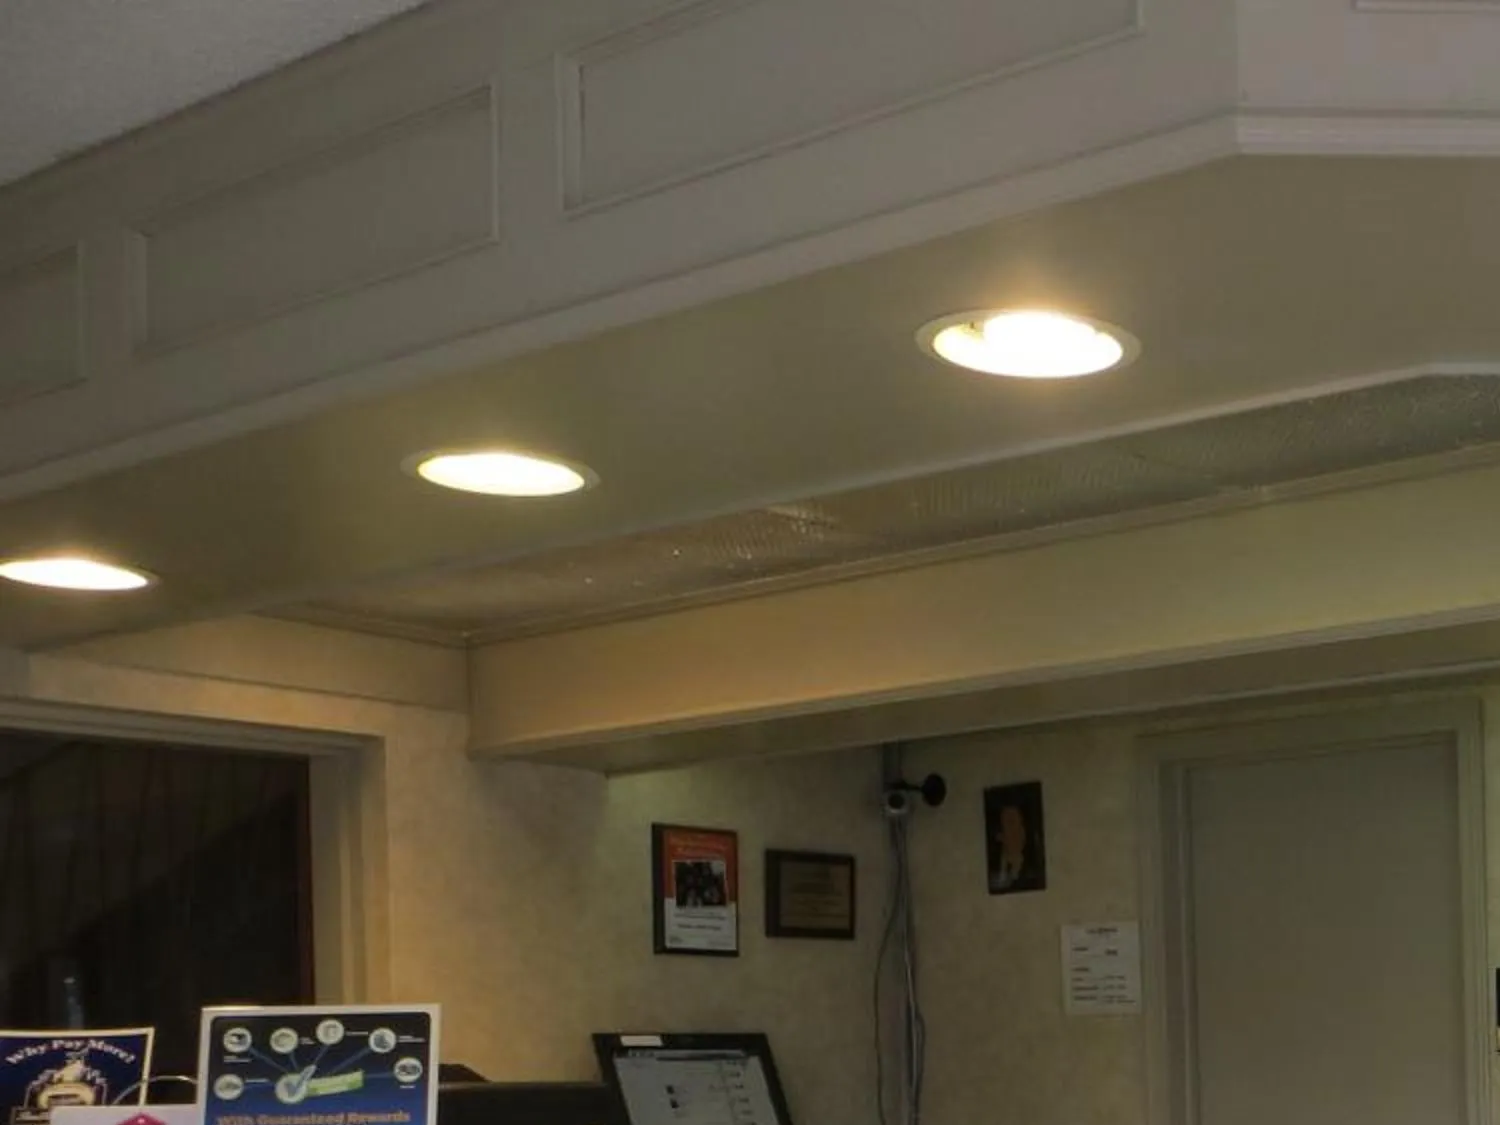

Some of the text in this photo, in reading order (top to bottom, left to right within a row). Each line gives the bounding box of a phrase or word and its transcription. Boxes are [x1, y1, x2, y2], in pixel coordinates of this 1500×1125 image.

[5, 1043, 47, 1064] Why
[51, 1038, 83, 1052] Pay
[257, 1113, 345, 1125] Guaranteed
[347, 1111, 411, 1124] Rewards
